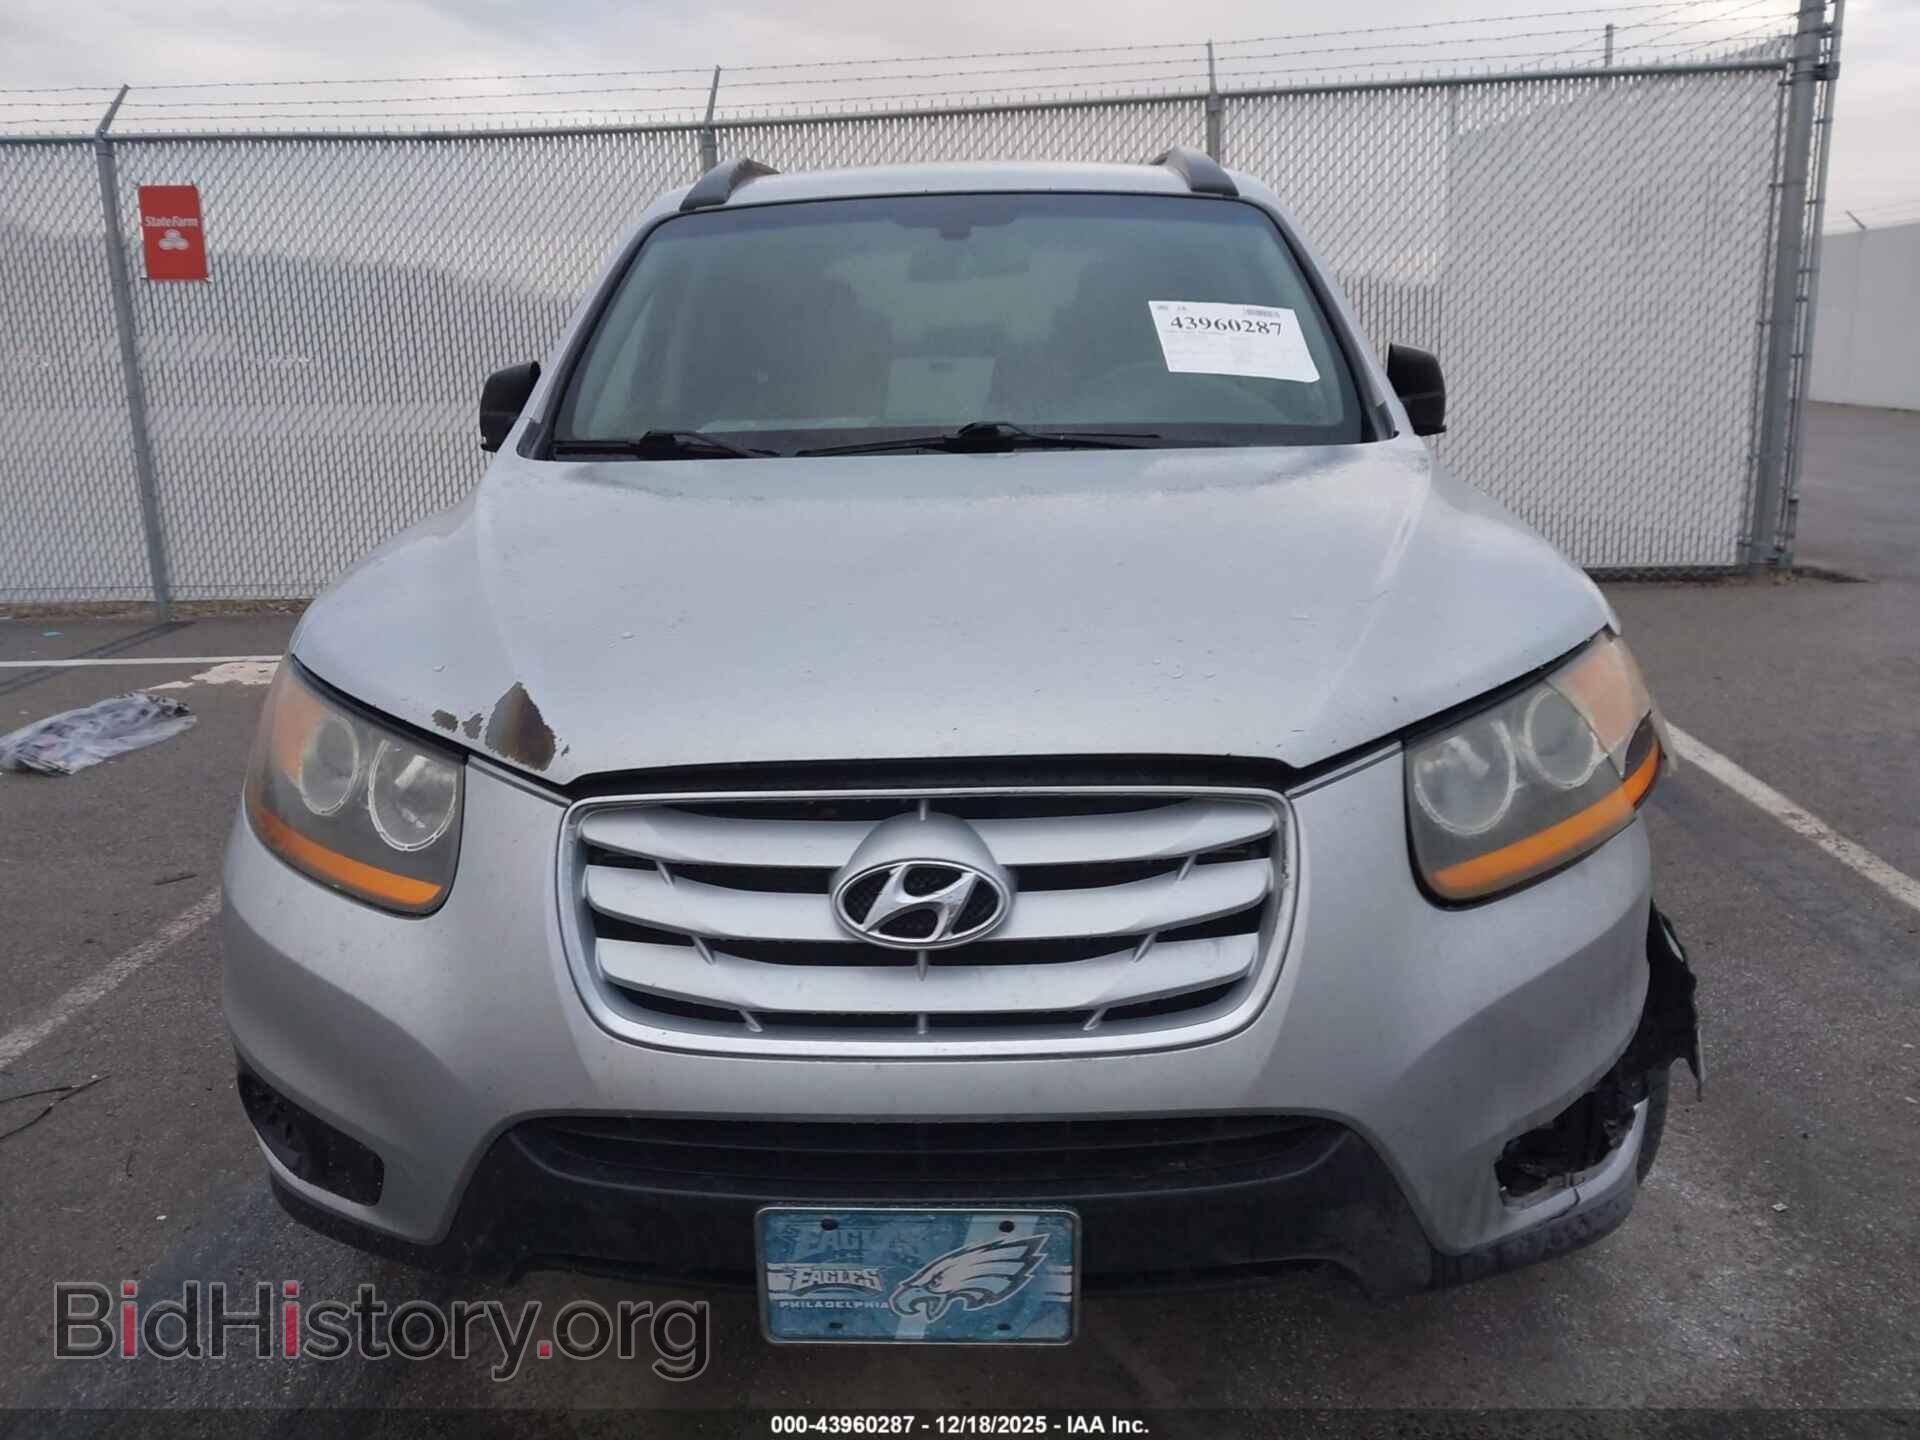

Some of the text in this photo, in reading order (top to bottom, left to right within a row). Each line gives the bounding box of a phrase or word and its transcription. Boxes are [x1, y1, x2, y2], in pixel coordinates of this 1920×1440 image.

[1170, 316, 1281, 336] 43960287
[792, 1267, 882, 1292] EAGLES
[779, 1300, 888, 1309] PHILADELPHIA
